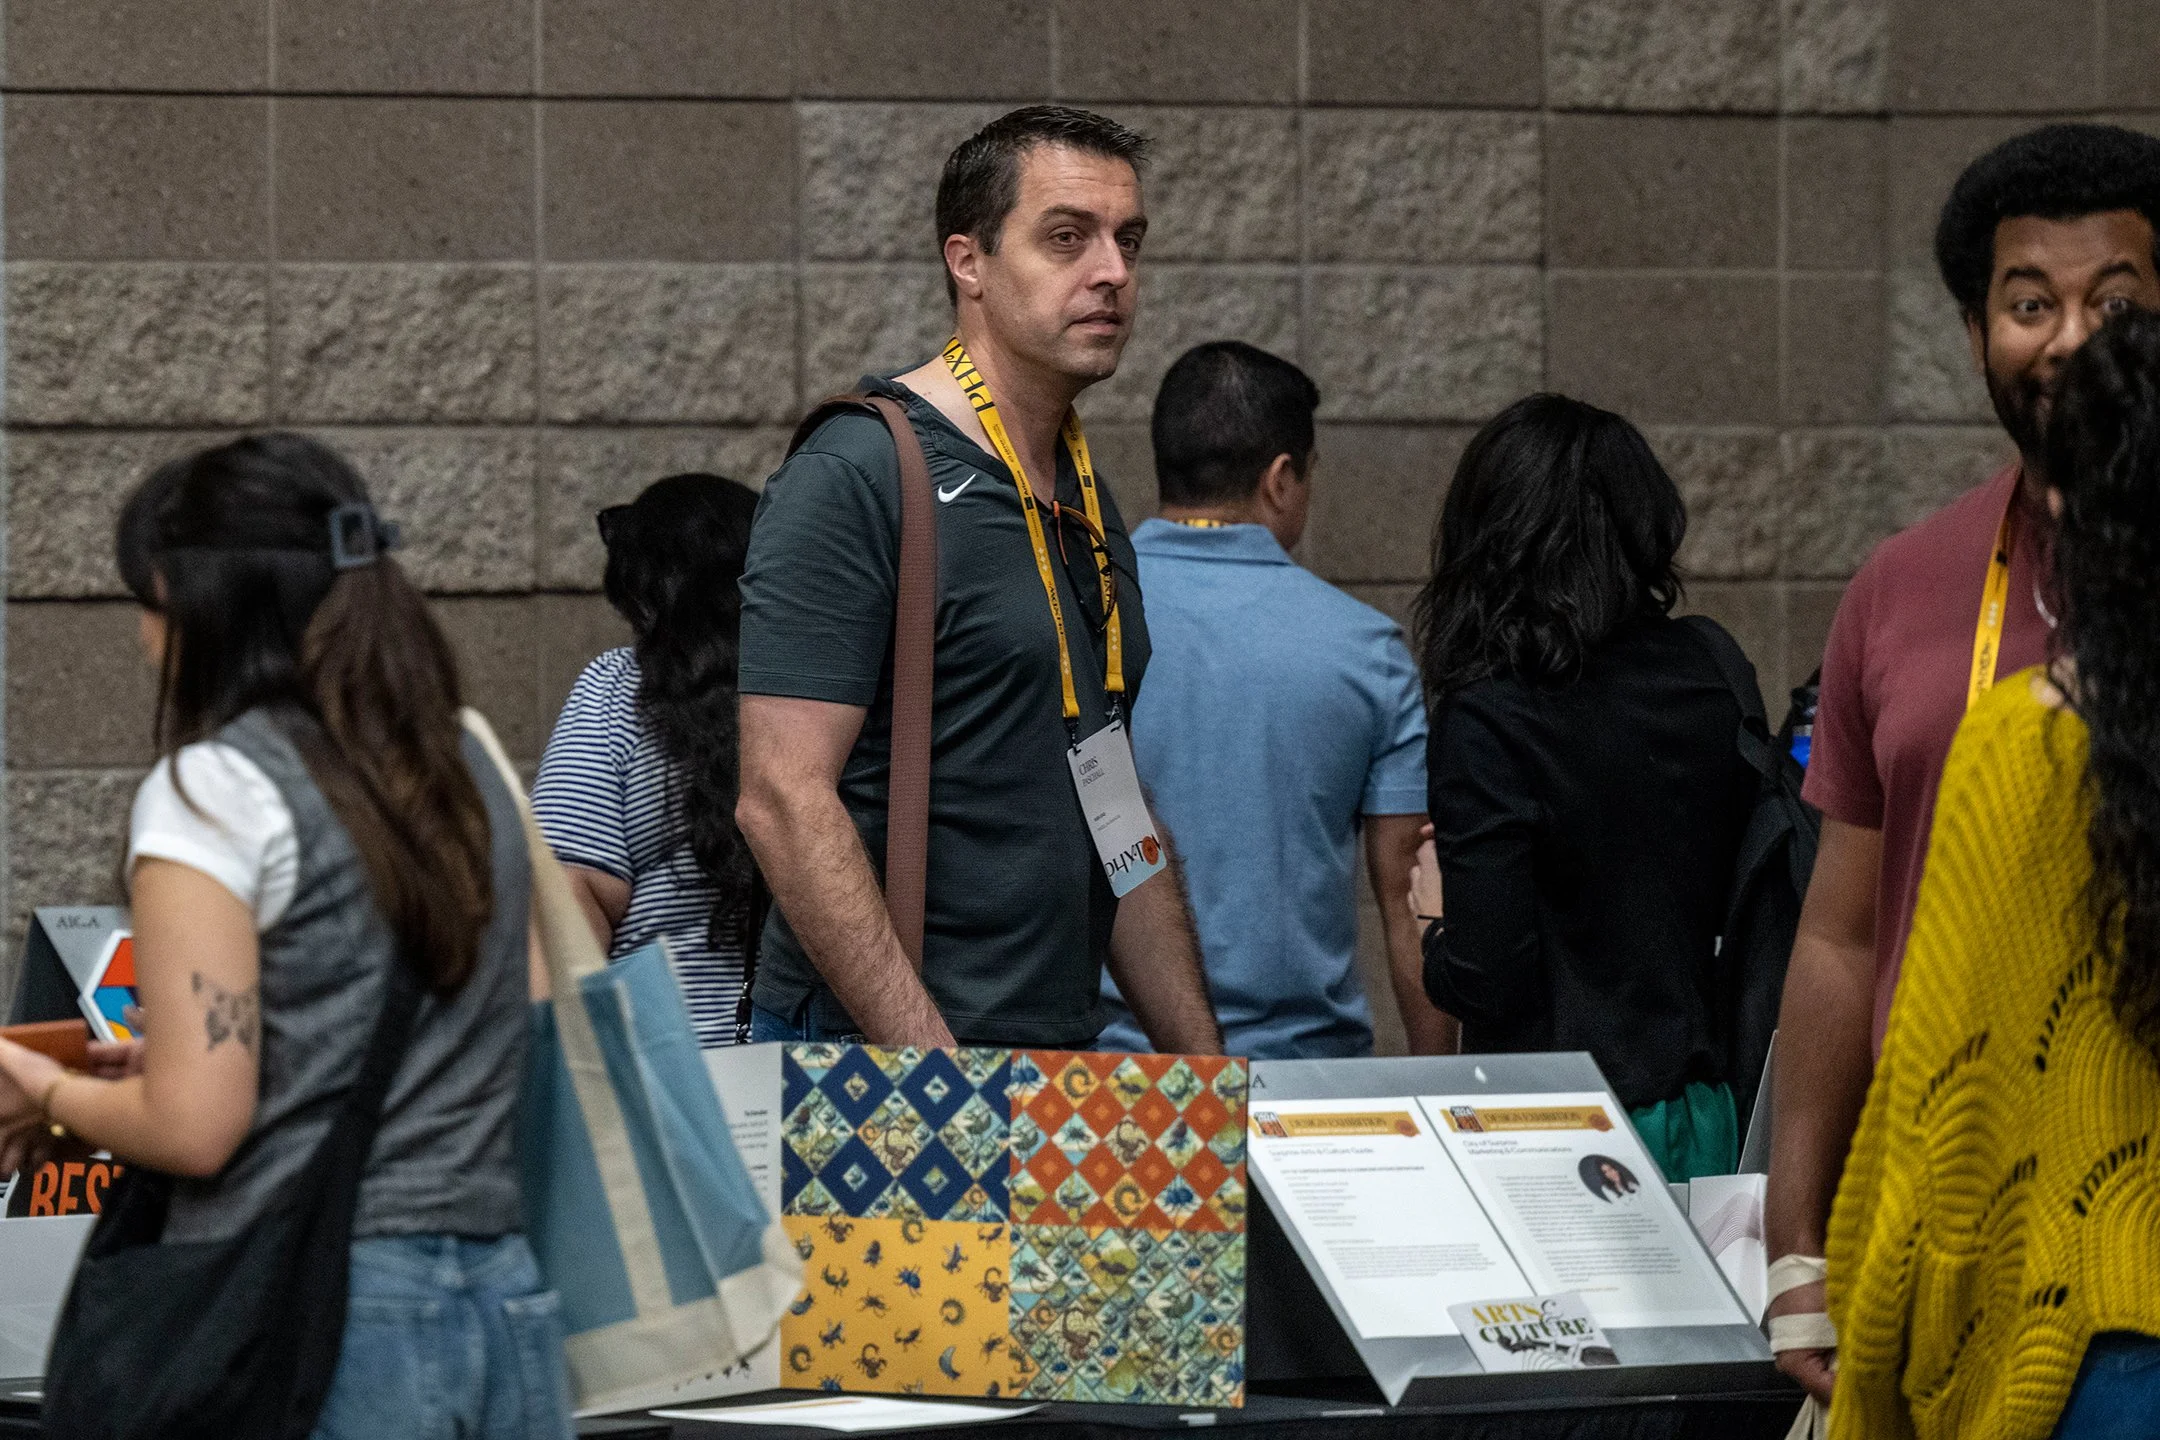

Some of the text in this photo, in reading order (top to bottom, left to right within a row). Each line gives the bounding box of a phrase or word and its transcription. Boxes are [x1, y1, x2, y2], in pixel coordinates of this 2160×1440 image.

[1078, 755, 1099, 776] CHRIS
[1471, 1303, 1543, 1325] ARTS
[1479, 1317, 1594, 1344] CULTURE
